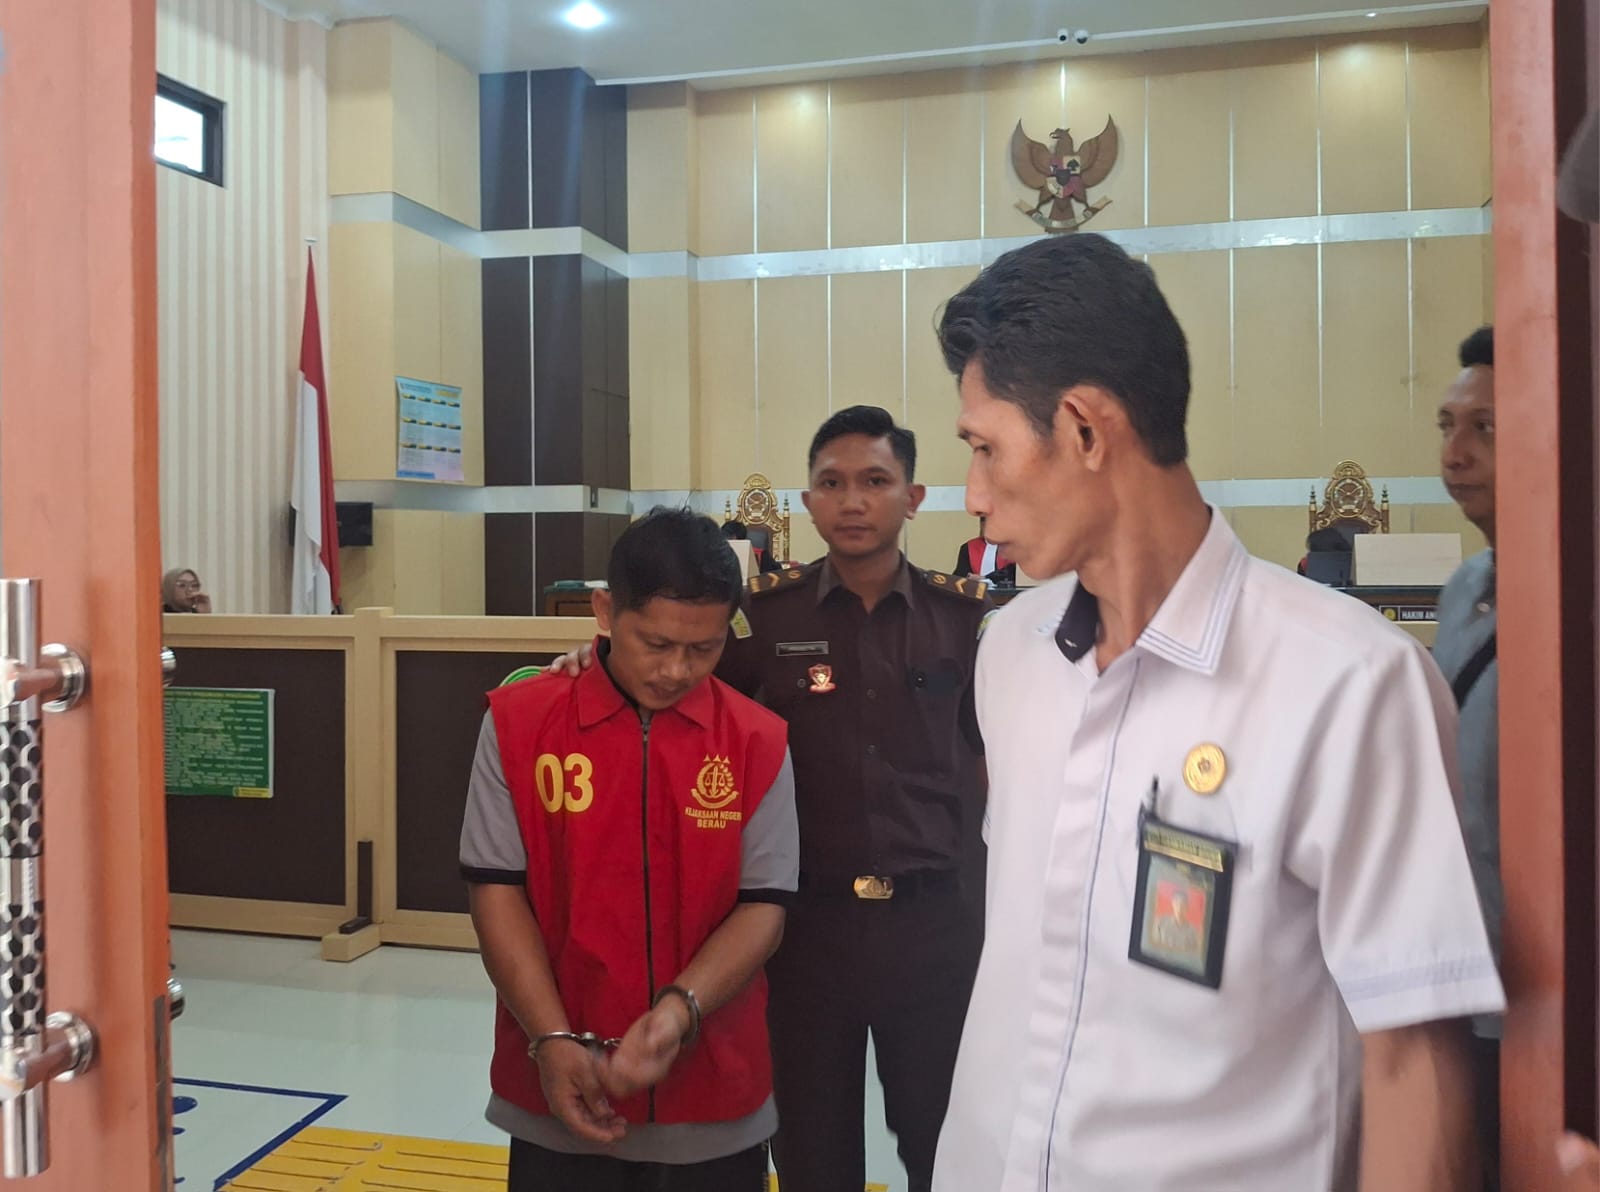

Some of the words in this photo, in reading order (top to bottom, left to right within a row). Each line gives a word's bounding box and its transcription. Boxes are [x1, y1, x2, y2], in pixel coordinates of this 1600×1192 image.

[1402, 610, 1423, 619] HAKIM
[535, 752, 594, 813] 03
[685, 807, 719, 819] KEJAKSAAN
[697, 819, 726, 829] BERAU
